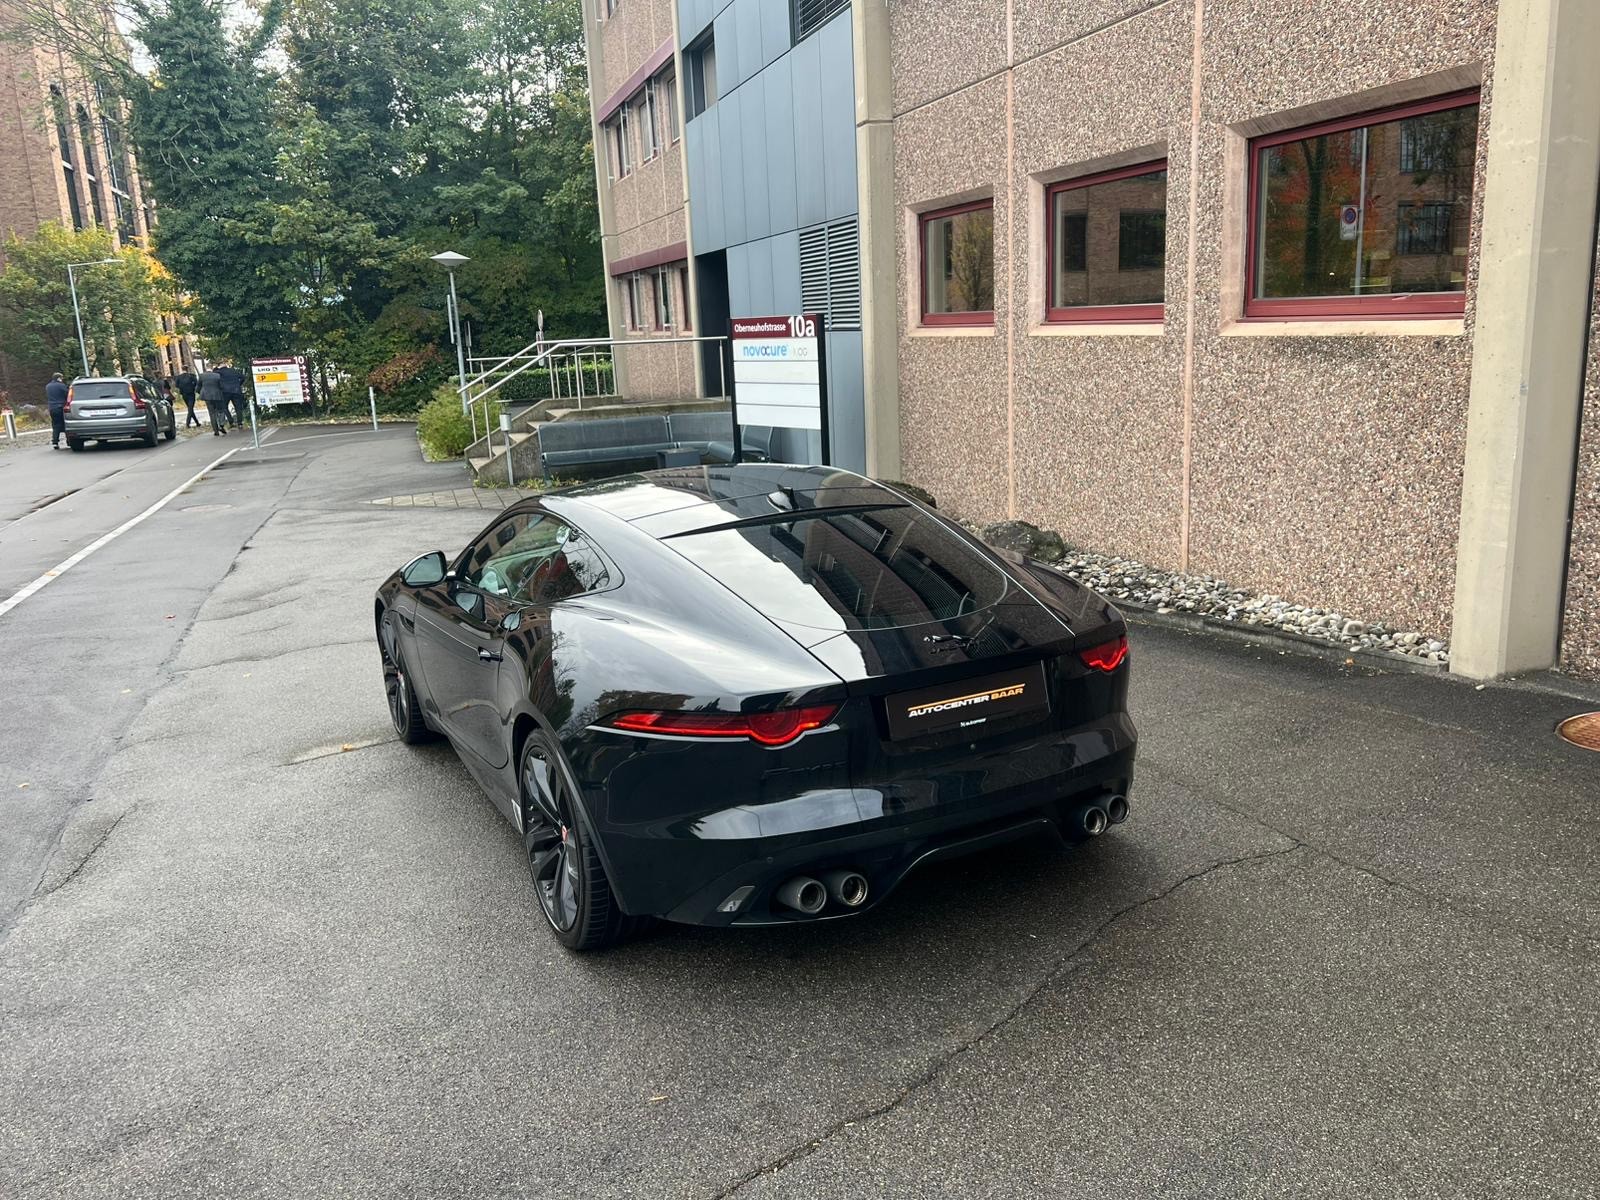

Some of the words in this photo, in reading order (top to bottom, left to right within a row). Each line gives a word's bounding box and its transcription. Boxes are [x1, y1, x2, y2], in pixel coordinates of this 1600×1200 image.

[734, 322, 786, 333] Oberneuhofstrasse
[787, 315, 815, 338] 10a
[293, 355, 305, 365] 10
[908, 694, 990, 718] AUTOCENTER
[990, 687, 1024, 700] BAAR
